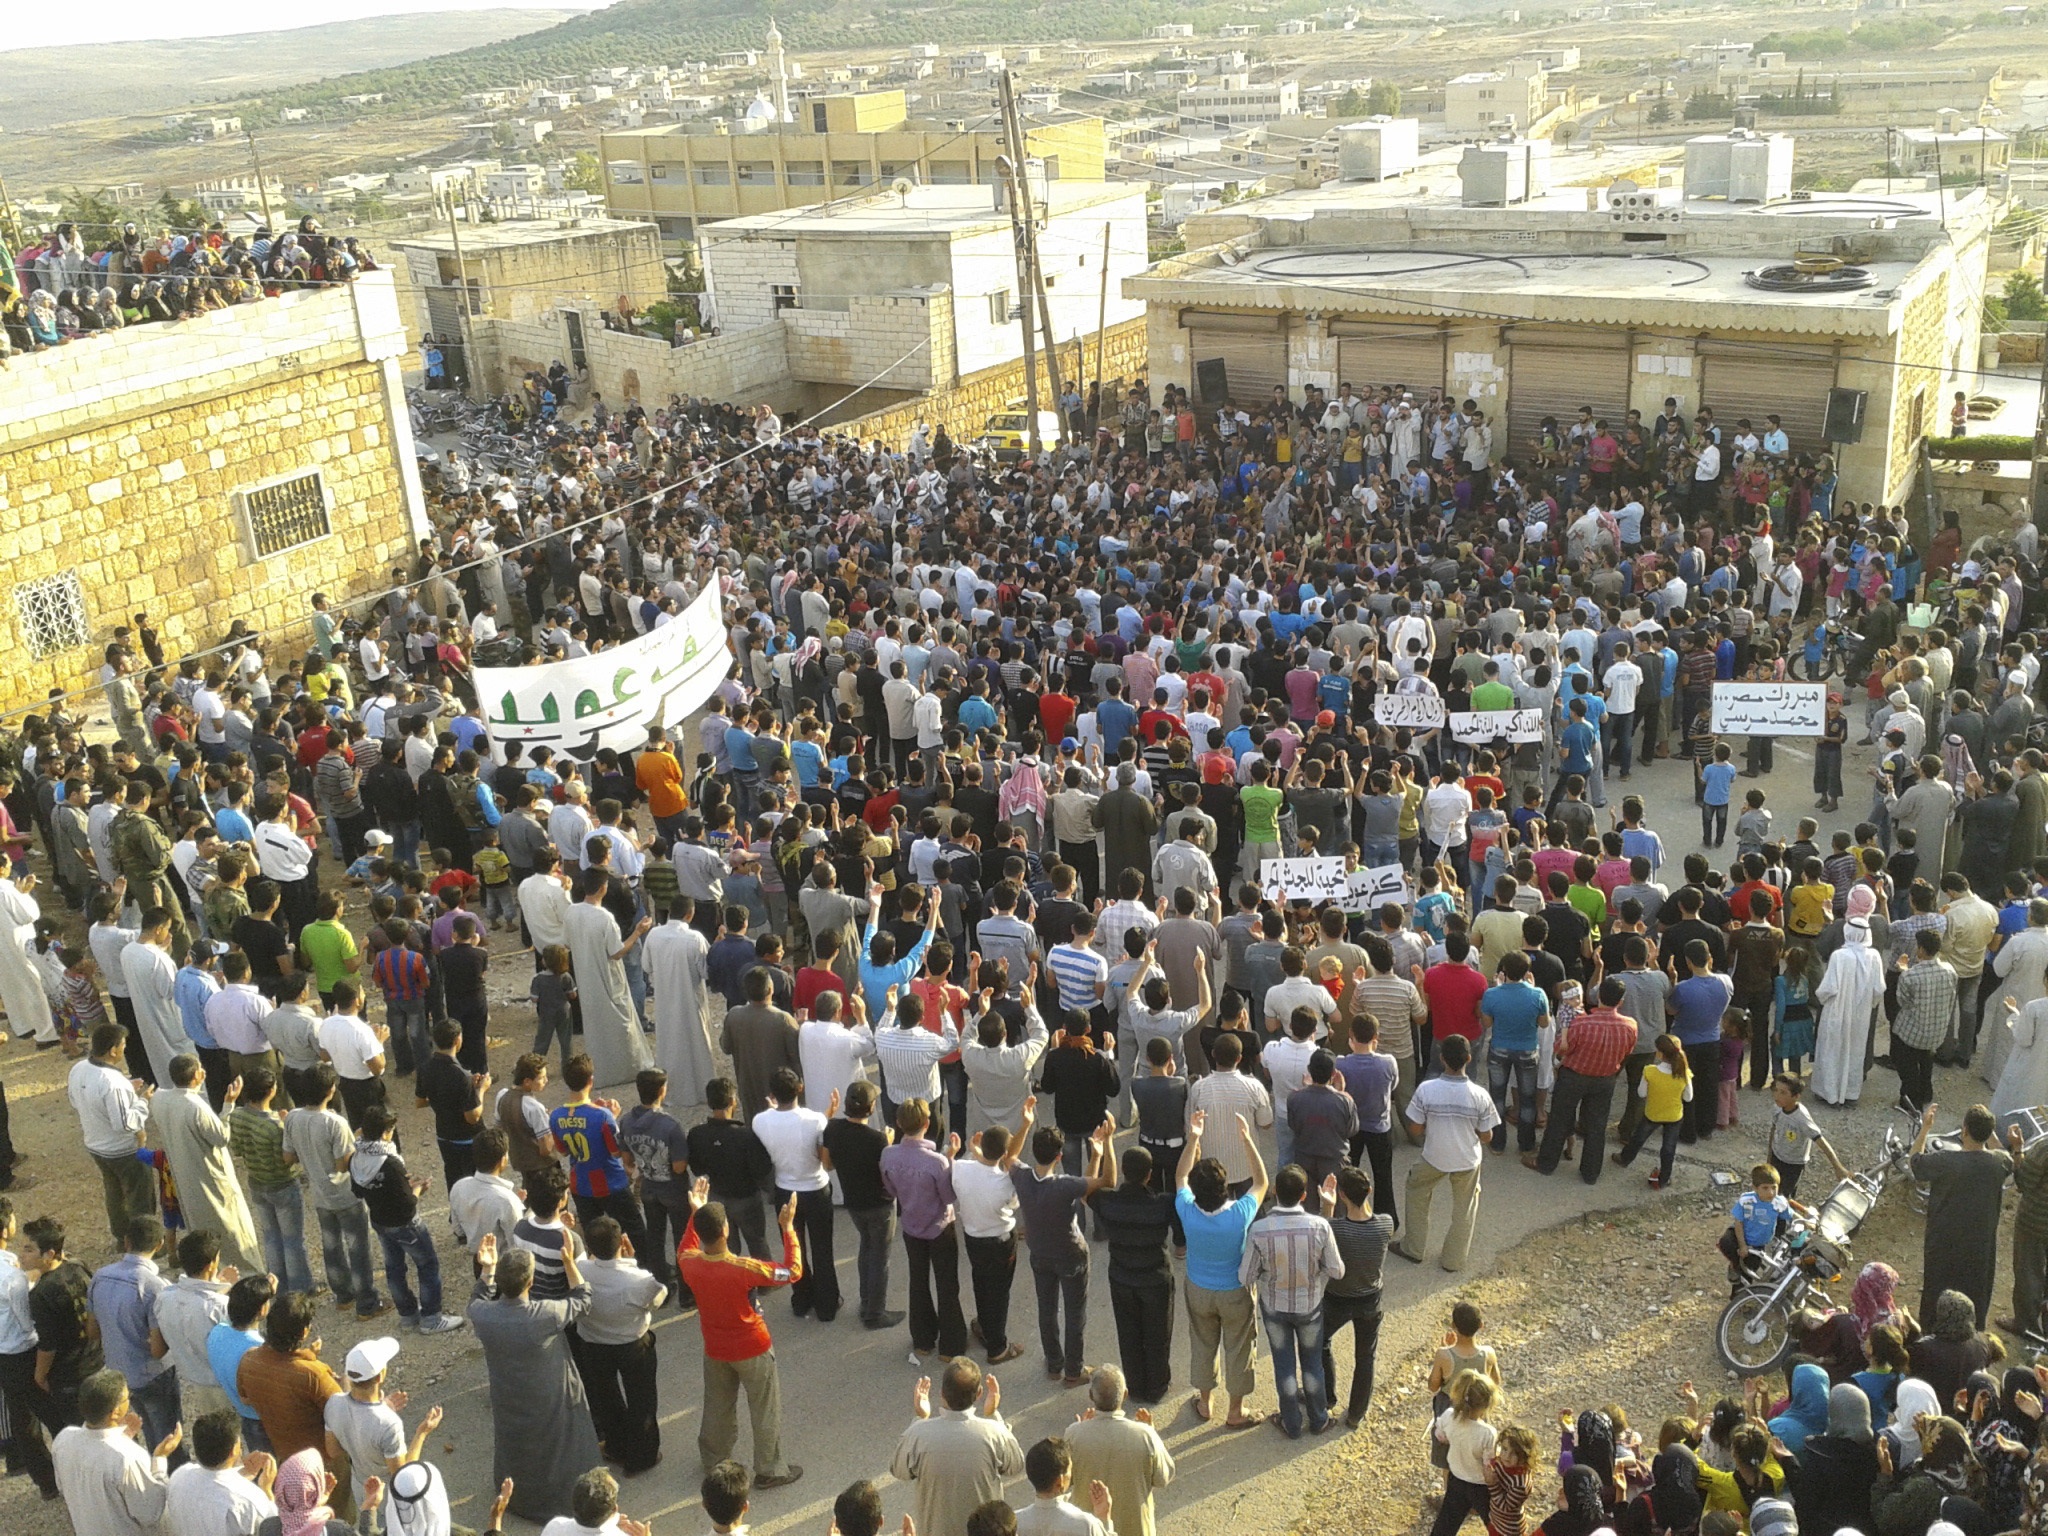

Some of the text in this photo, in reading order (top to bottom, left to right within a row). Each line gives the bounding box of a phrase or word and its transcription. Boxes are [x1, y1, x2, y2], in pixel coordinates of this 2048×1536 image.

[1766, 686, 1819, 710] مبروك
[1523, 712, 1540, 733] الله
[1719, 711, 1819, 732] محمد مرسي
[1316, 860, 1345, 895] تحية
[1366, 872, 1403, 908] كفر
[557, 1117, 588, 1130] MESSI
[562, 1131, 591, 1162] 10
